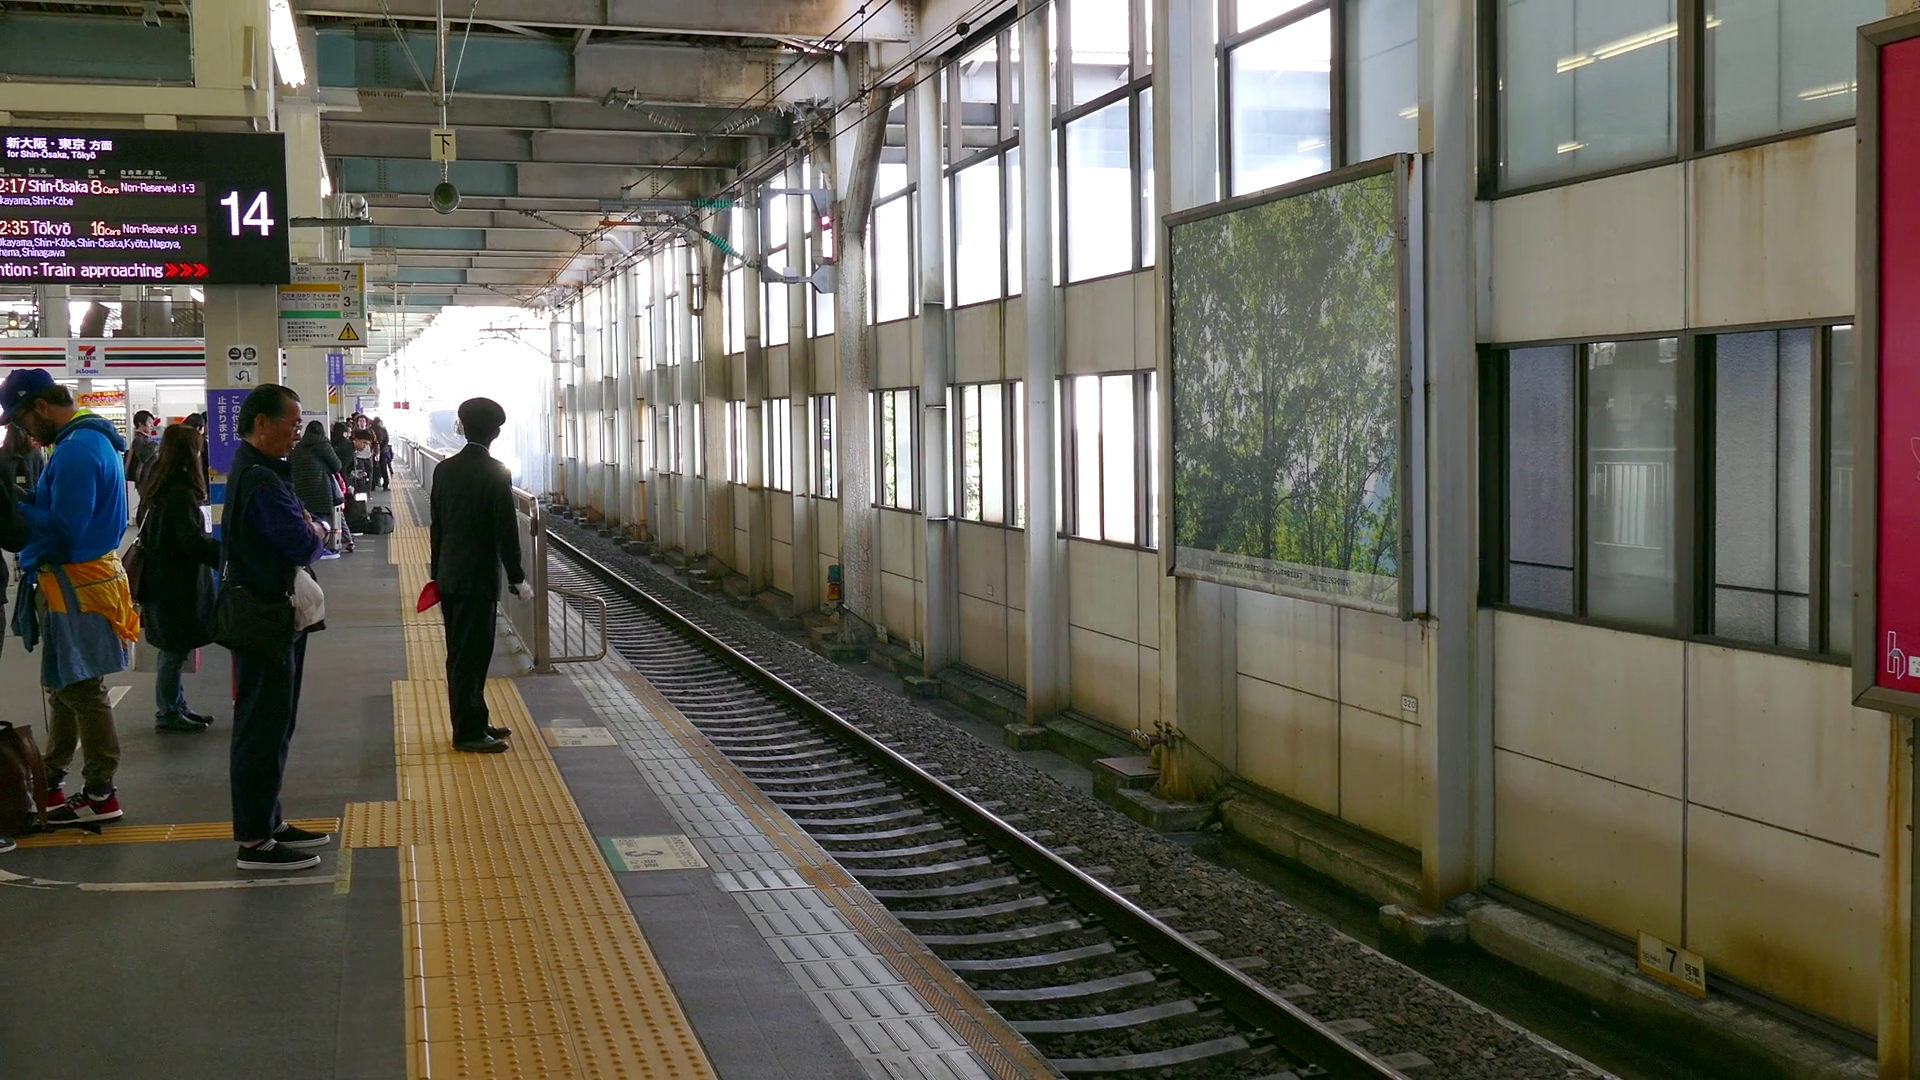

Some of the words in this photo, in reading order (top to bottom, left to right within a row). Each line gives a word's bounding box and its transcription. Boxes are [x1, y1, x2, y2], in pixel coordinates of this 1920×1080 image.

[6, 137, 86, 150] 新大阪・東京
[89, 140, 113, 151] 方面
[434, 133, 453, 155] 下
[7, 150, 19, 158] for
[71, 151, 97, 161] Tōkyō
[28, 179, 88, 193] Shin-Ōsaka
[220, 191, 274, 236] 14
[0, 220, 28, 235] 2:35
[30, 220, 71, 236] Tōkyō
[39, 262, 76, 277] Train
[81, 263, 163, 278] approaching
[343, 270, 351, 281] 7
[343, 296, 351, 307] 3
[78, 346, 96, 367] 7
[217, 395, 229, 446] 止まります。
[1665, 947, 1677, 973] 7
